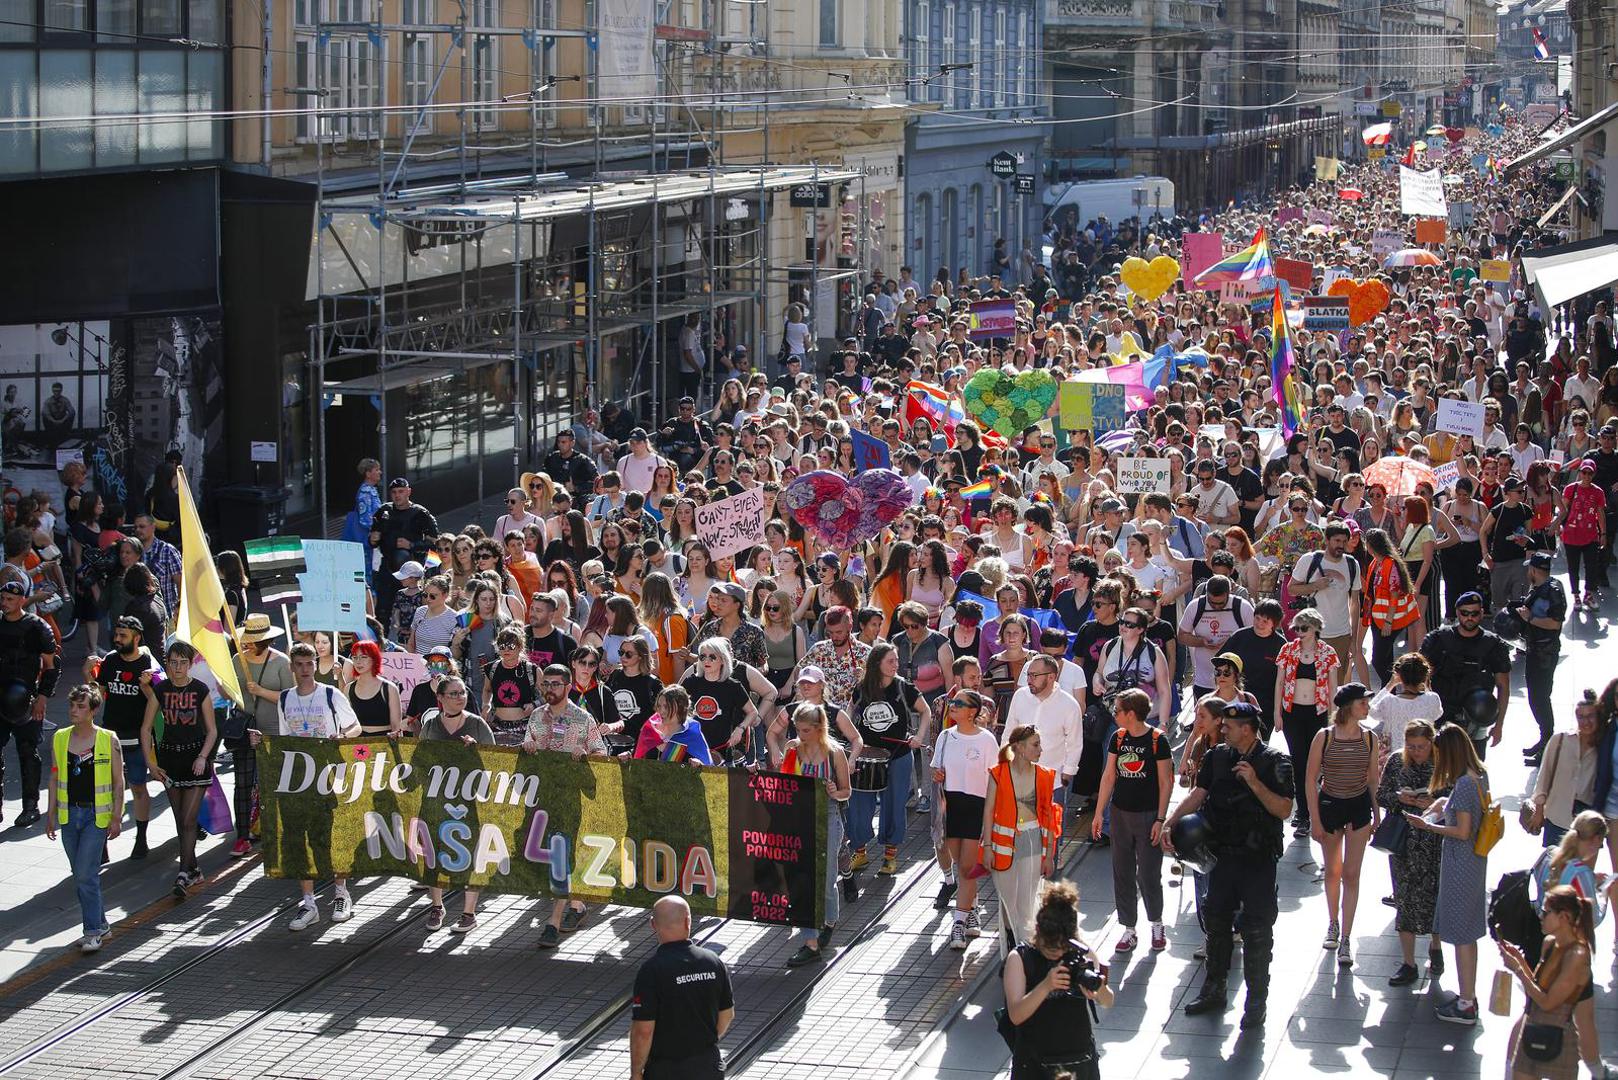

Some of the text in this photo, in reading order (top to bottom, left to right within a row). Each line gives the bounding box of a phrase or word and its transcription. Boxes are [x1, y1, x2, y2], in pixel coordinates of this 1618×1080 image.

[1308, 306, 1349, 316] SLATKA
[1133, 460, 1147, 470] BE
[1121, 471, 1169, 480] PROUD OF
[733, 492, 759, 514] EVEN
[113, 670, 122, 682] I
[107, 681, 140, 696] PARIS
[163, 691, 198, 709] TRUE
[273, 744, 540, 808] Dajte nam
[748, 774, 799, 792] ZAGREB
[754, 789, 793, 806] PRIDE
[363, 802, 511, 876] NAŠA
[742, 830, 803, 849] POVORKA
[745, 844, 799, 863] PONOSA
[676, 971, 716, 985] SECURITAS
